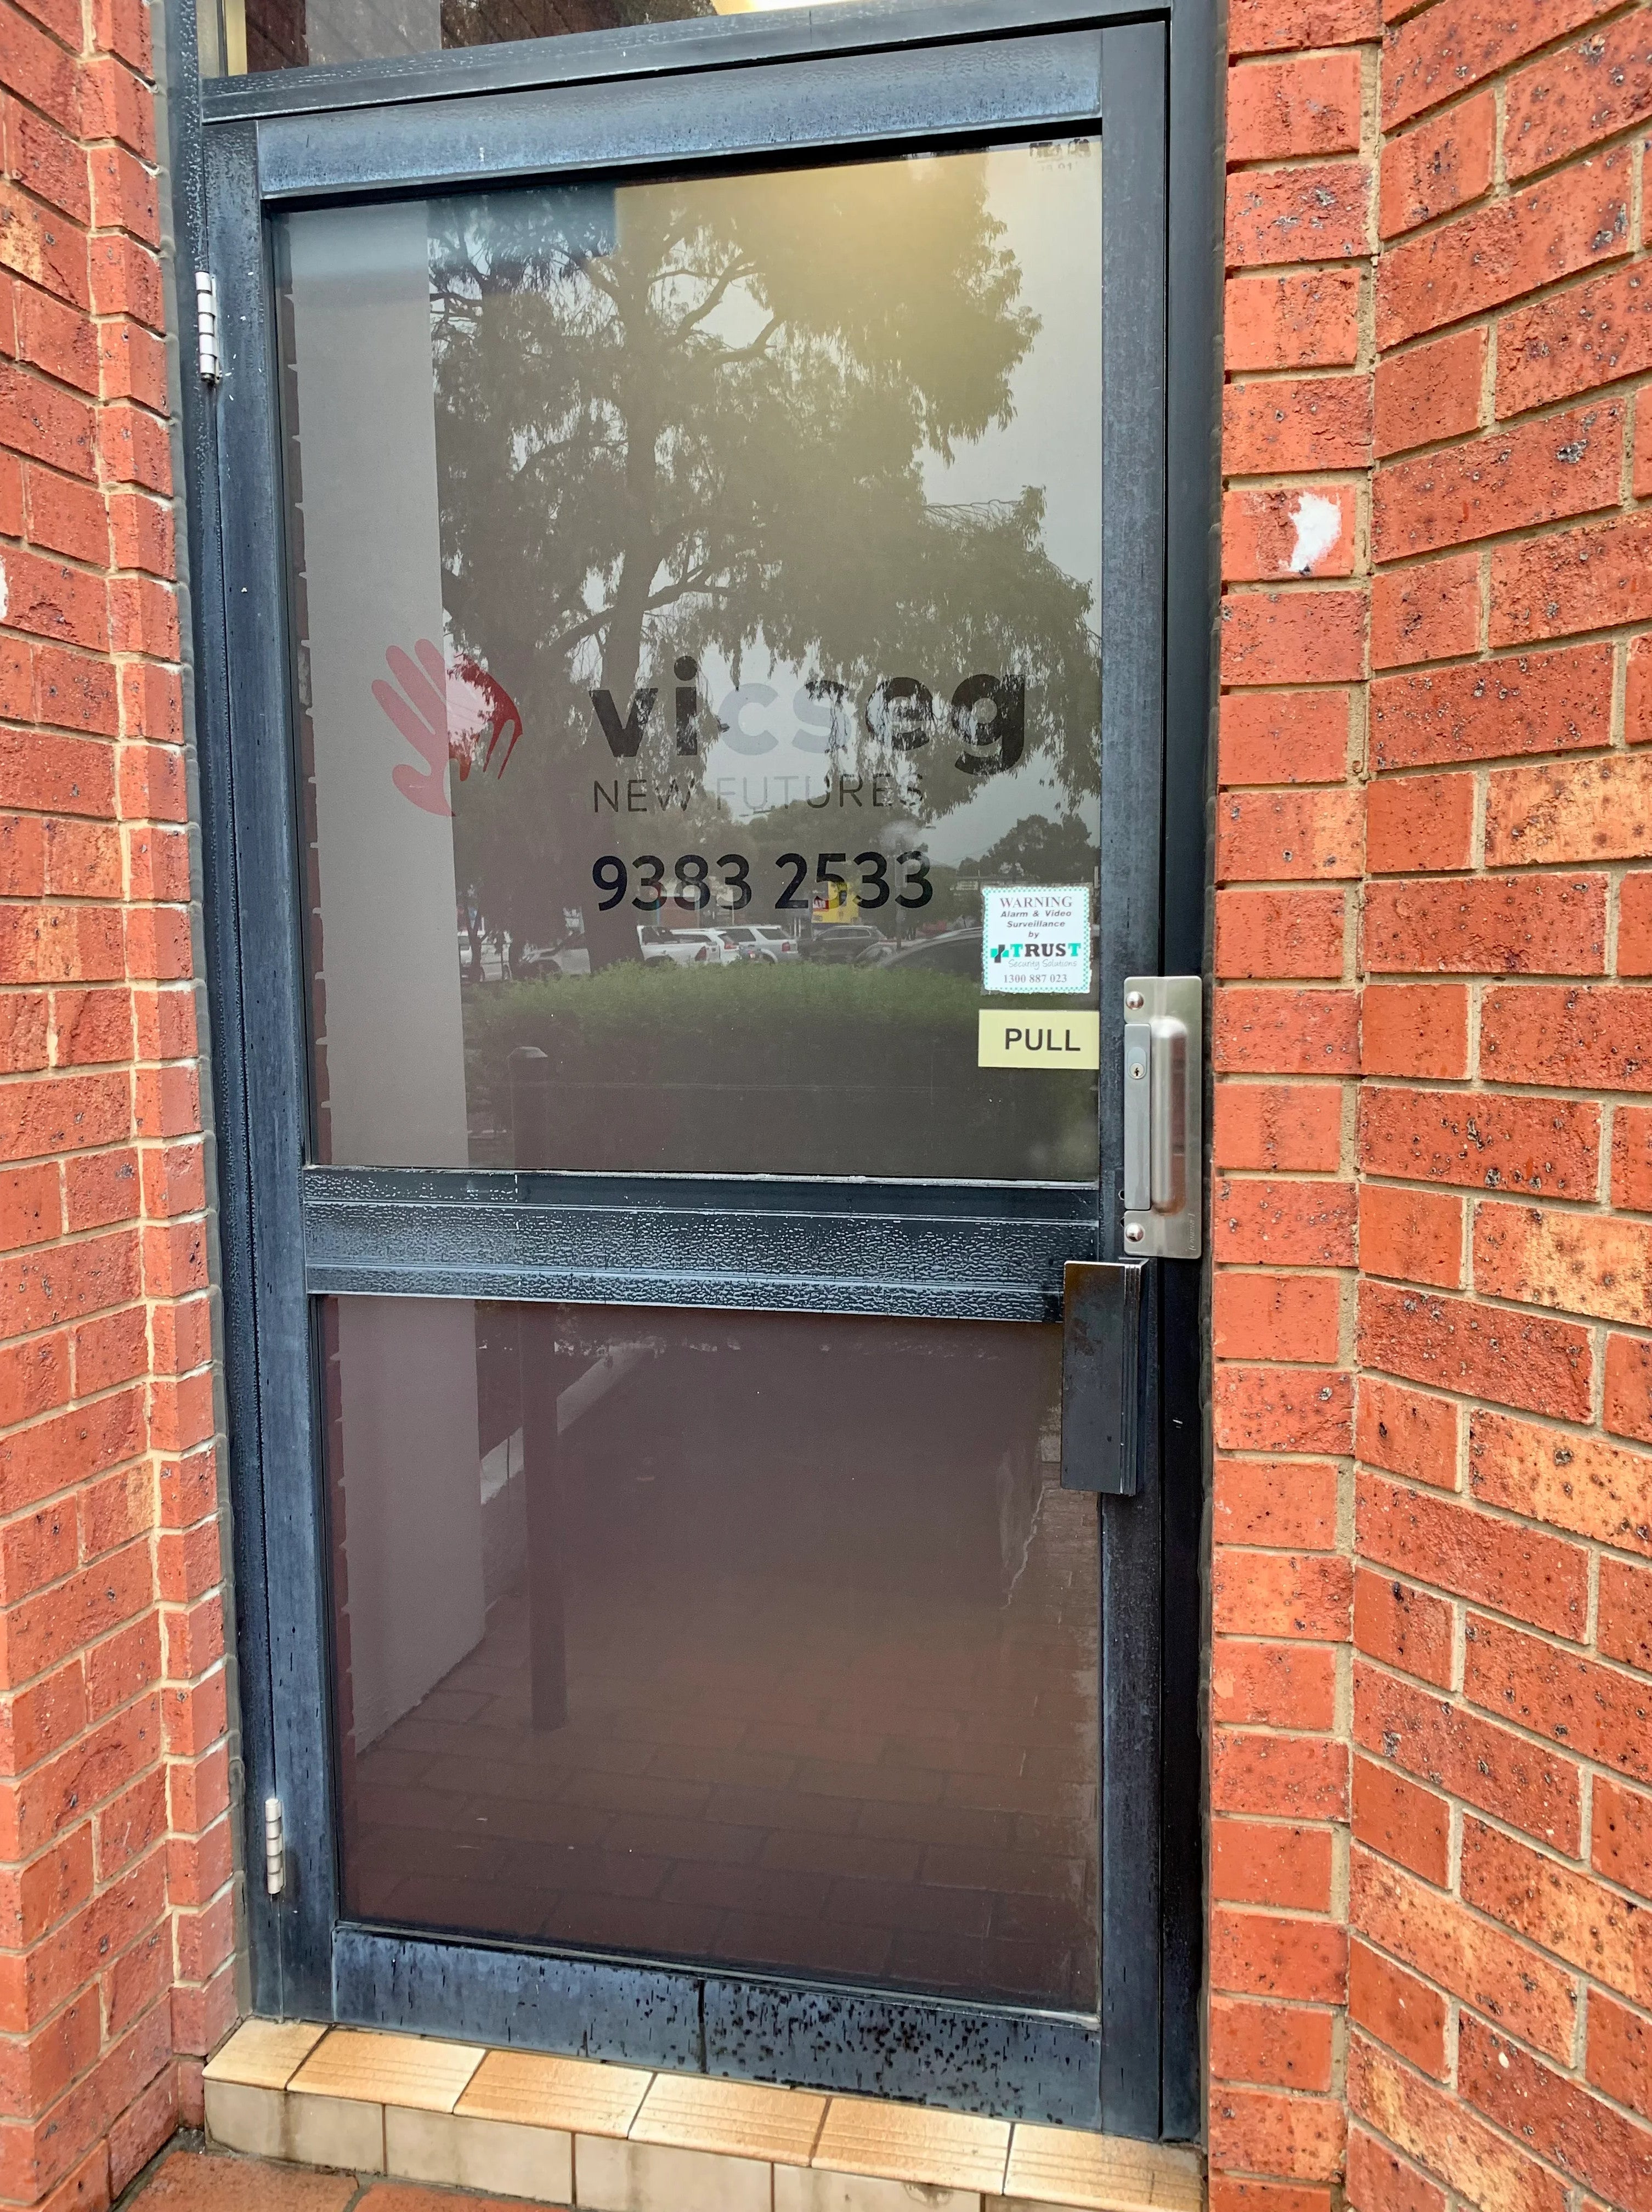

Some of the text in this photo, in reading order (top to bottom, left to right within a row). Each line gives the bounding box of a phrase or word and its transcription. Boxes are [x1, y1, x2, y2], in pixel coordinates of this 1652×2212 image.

[590, 656, 1025, 775] vicseg
[593, 772, 924, 813] NEW FUTURES
[592, 850, 935, 911] 9383 2533
[999, 896, 1073, 908] WARNING
[1010, 943, 1082, 957] TRUST
[1008, 958, 1077, 970] Security Solutions
[1004, 974, 1067, 983] 1300 887 023
[1005, 1028, 1081, 1052] PULL
